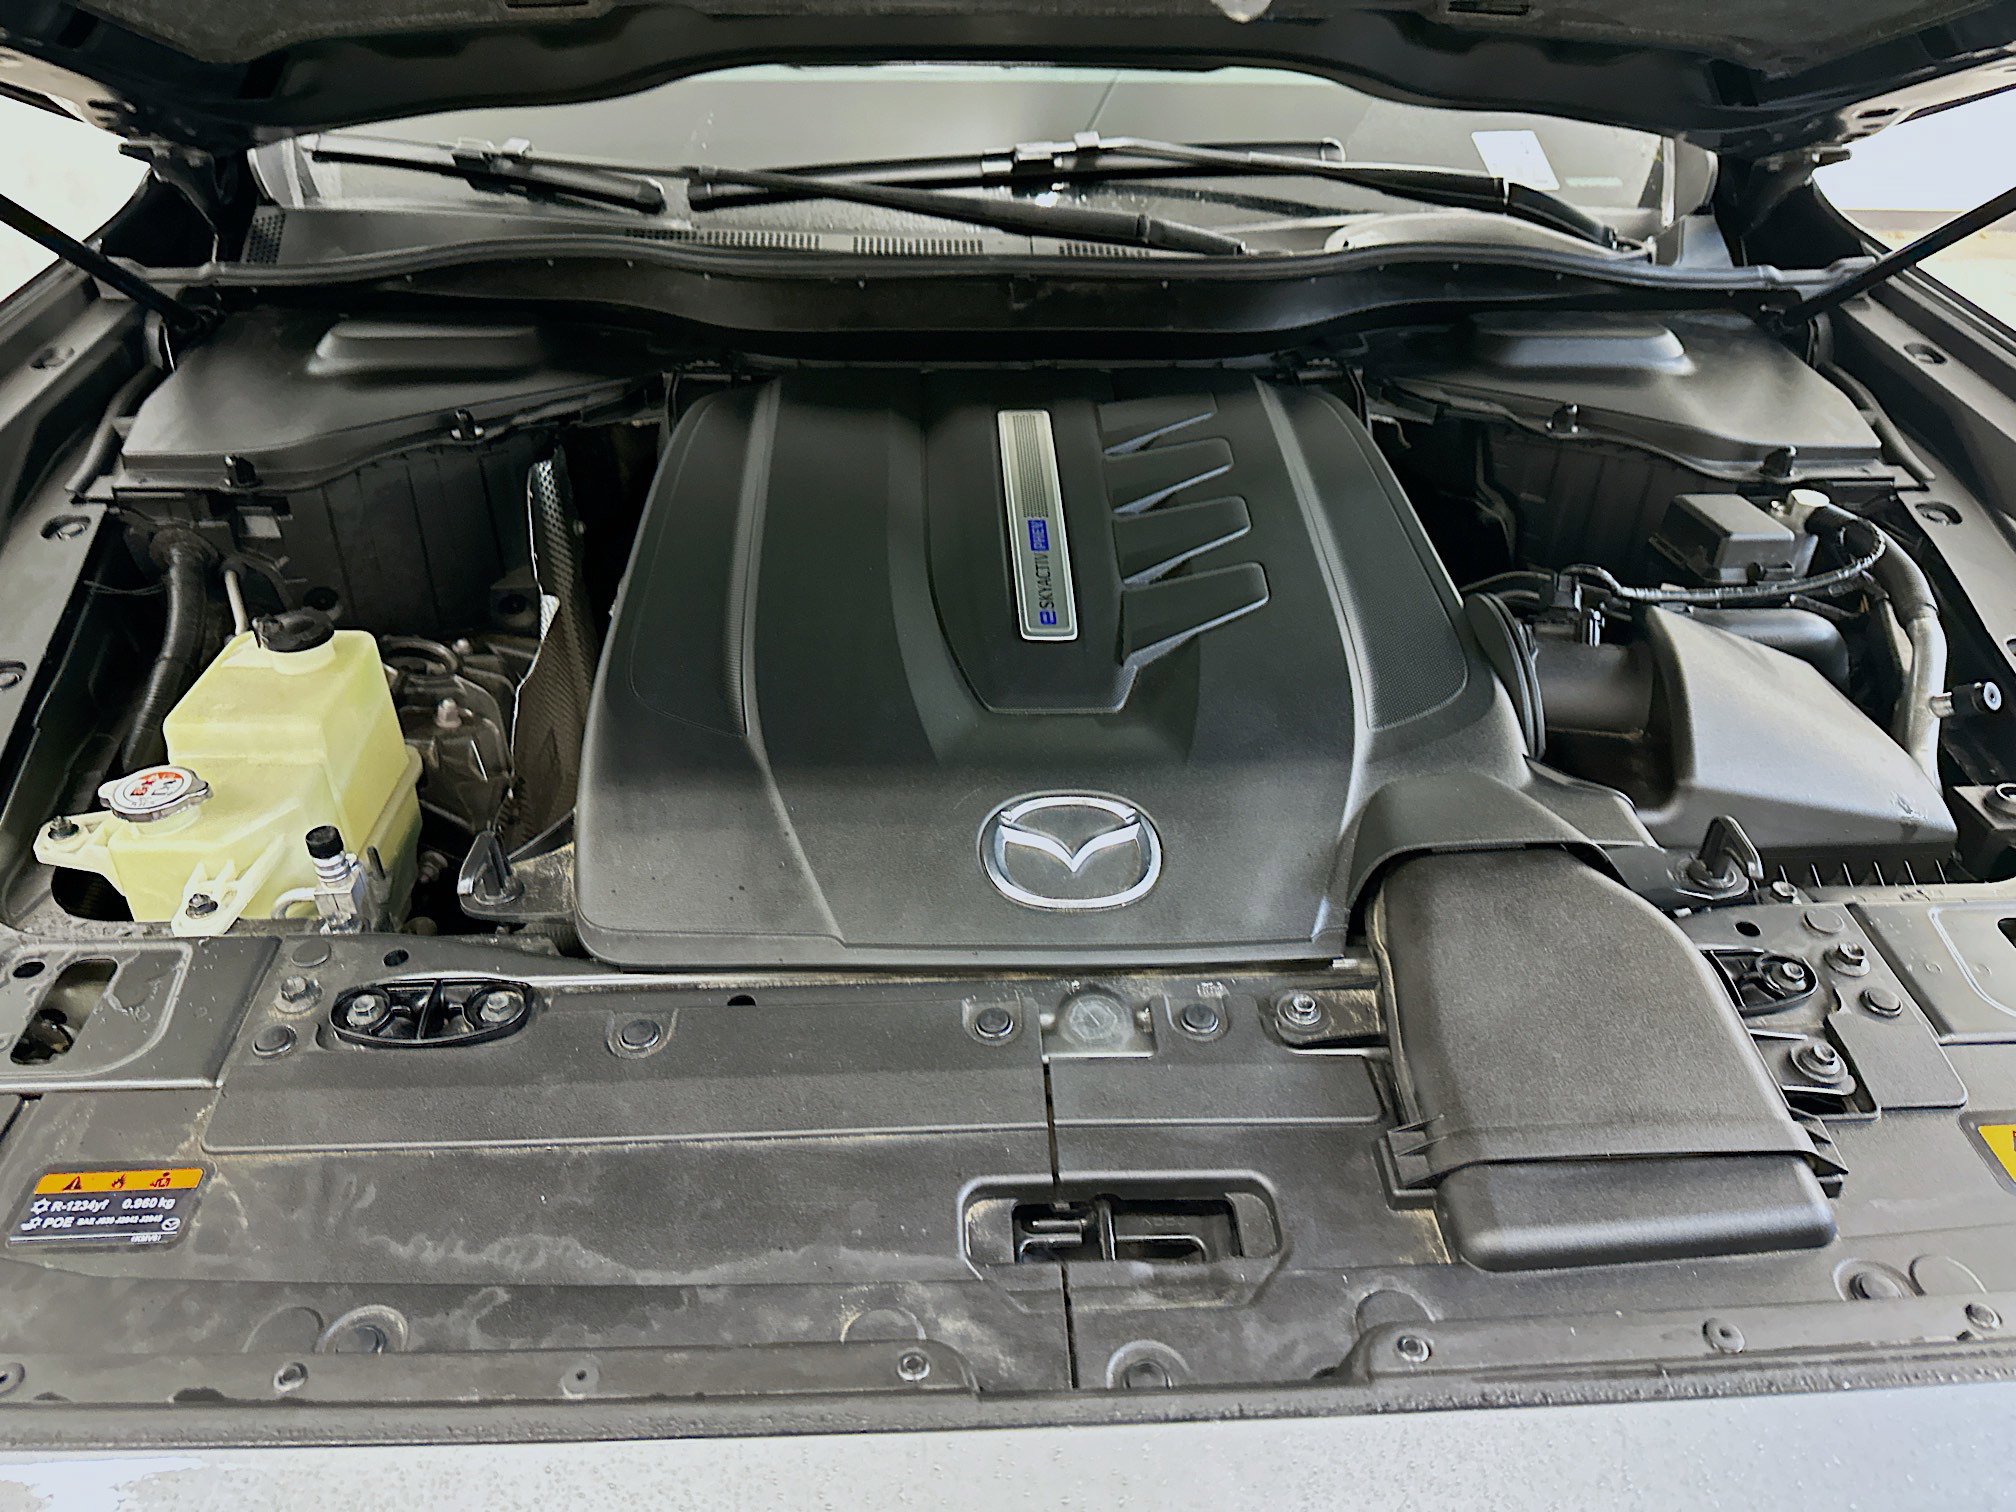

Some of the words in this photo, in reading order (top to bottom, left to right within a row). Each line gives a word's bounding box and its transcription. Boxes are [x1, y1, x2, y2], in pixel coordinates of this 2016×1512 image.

[50, 1198, 109, 1213] R-1234yf
[158, 1197, 176, 1210] kg
[42, 1216, 75, 1229] POE
